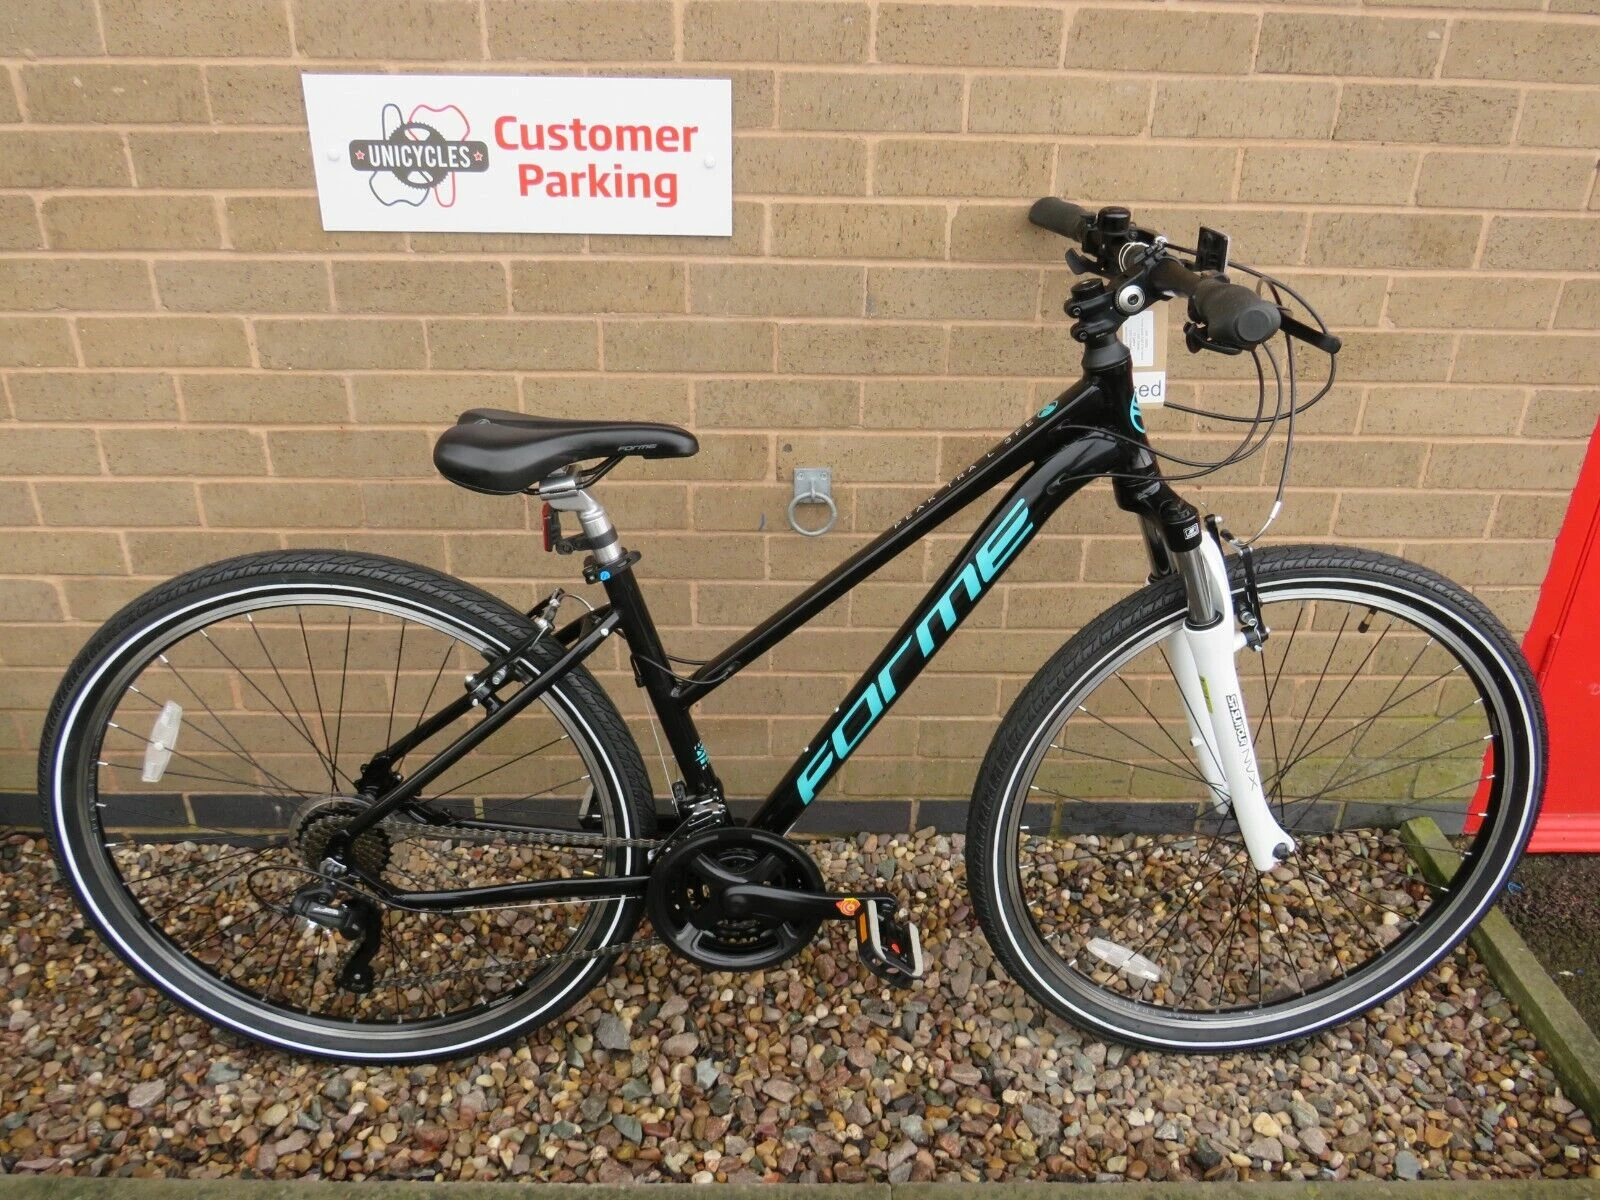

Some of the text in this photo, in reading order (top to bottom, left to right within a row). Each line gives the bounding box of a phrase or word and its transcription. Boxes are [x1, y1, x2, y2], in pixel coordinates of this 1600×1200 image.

[494, 116, 698, 152] Customer
[368, 144, 471, 169] UNICYCLES
[518, 164, 678, 208] Parking
[1135, 380, 1162, 397] ed
[947, 452, 995, 487] TRAL
